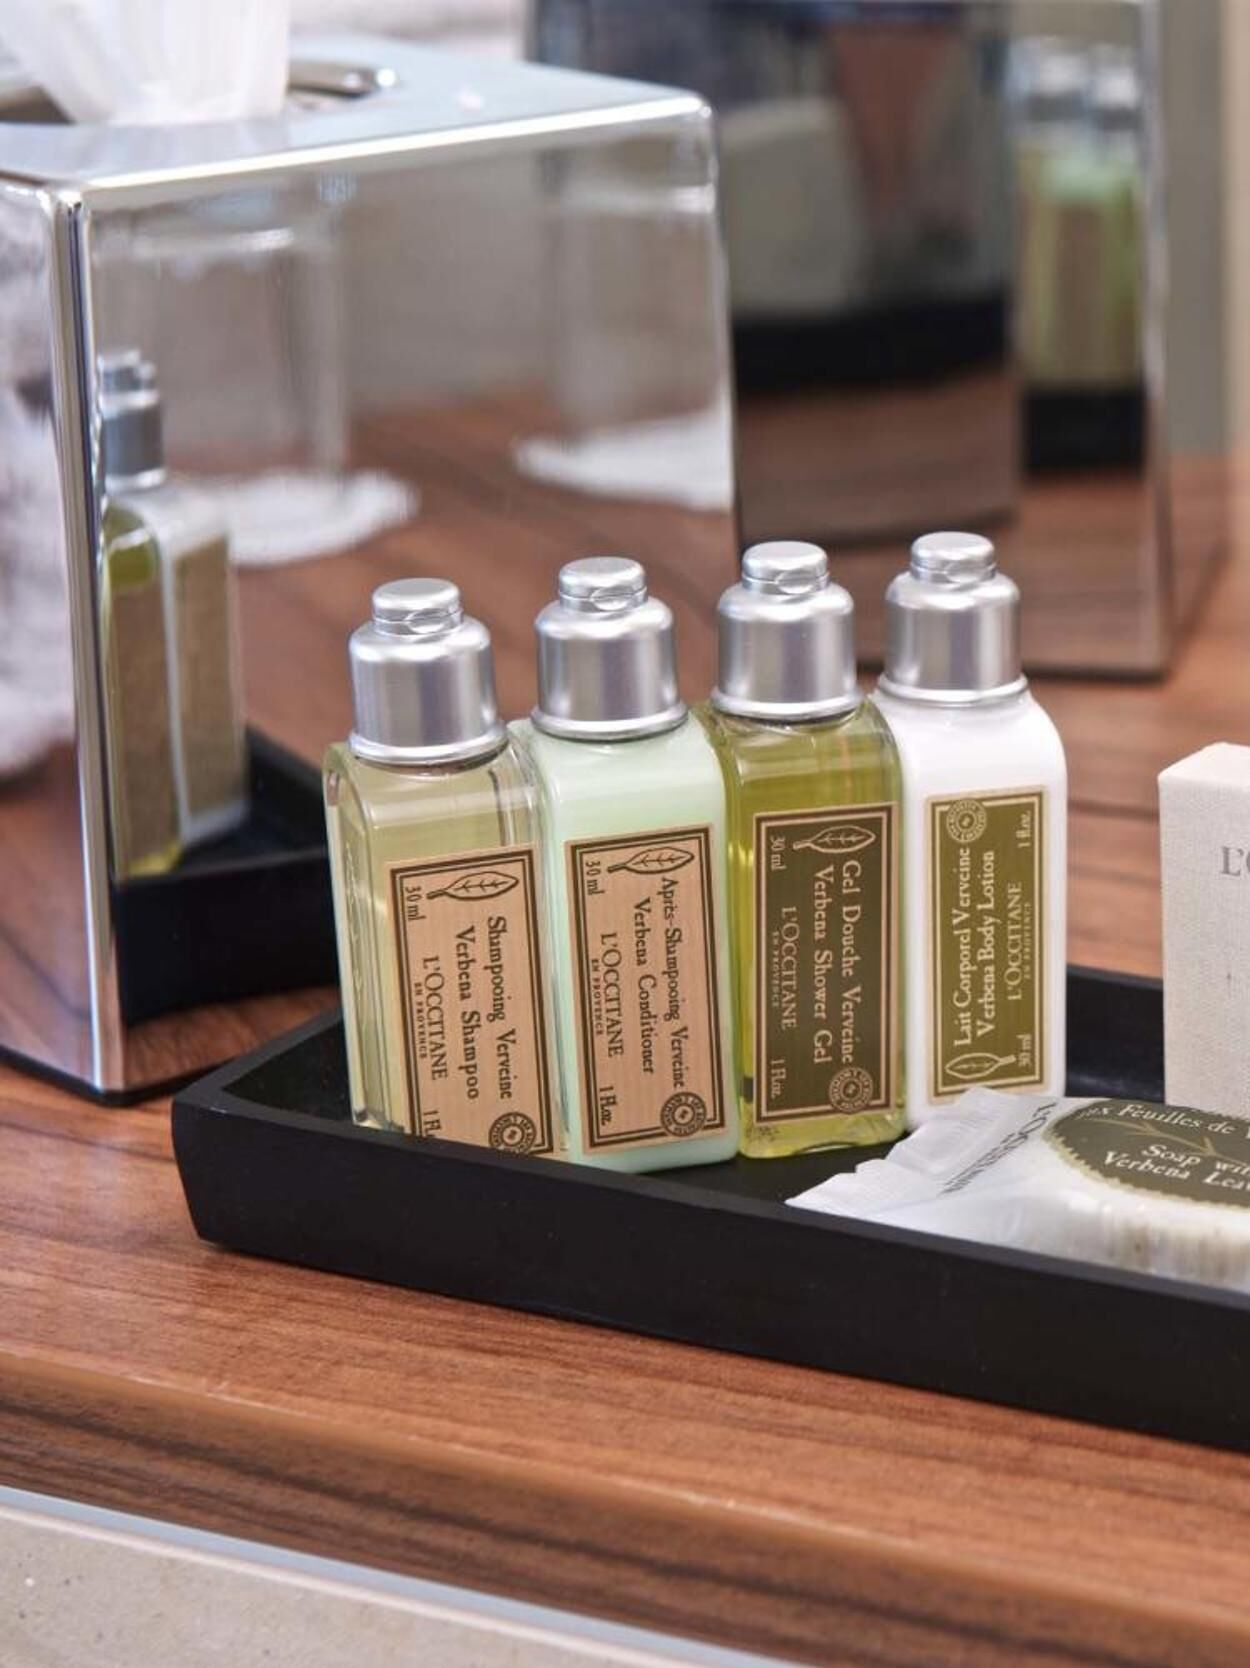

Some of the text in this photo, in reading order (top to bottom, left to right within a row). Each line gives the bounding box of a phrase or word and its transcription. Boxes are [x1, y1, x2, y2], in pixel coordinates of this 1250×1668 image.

[585, 860, 605, 896] 30 ml
[770, 853, 787, 871] ml
[841, 859, 862, 894] Gel
[952, 846, 972, 926] Verveine
[405, 886, 427, 921] 30 ml
[841, 905, 862, 978] Douche
[977, 850, 1002, 1037] Verbena Body Lotion
[1003, 881, 1023, 1001] L'OCCITANE
[487, 915, 511, 1022] Shampooing
[600, 931, 624, 1059] L'OCCITANE
[633, 896, 657, 1075] Verbena Conditioner
[656, 876, 684, 1022] Après-Shampooing
[671, 1025, 689, 1090] Verveine
[780, 905, 801, 1031] L'OCCITANE
[813, 864, 835, 1065] Verbena Shower Gel
[952, 927, 977, 1008] Corporel
[415, 1001, 428, 1060] PROVENCE
[421, 954, 448, 1082] L'OCCITANE
[454, 925, 481, 1101] Verbena Shampoo
[592, 977, 604, 1037] PROVENCE
[841, 985, 862, 1065] Verveine
[953, 1011, 972, 1047] Lait
[497, 1027, 517, 1100] Verveine
[1117, 1103, 1203, 1129] Feuilles
[1207, 1119, 1236, 1135] de
[1141, 1143, 1201, 1167] Soap
[1101, 1151, 1191, 1180] Verbena
